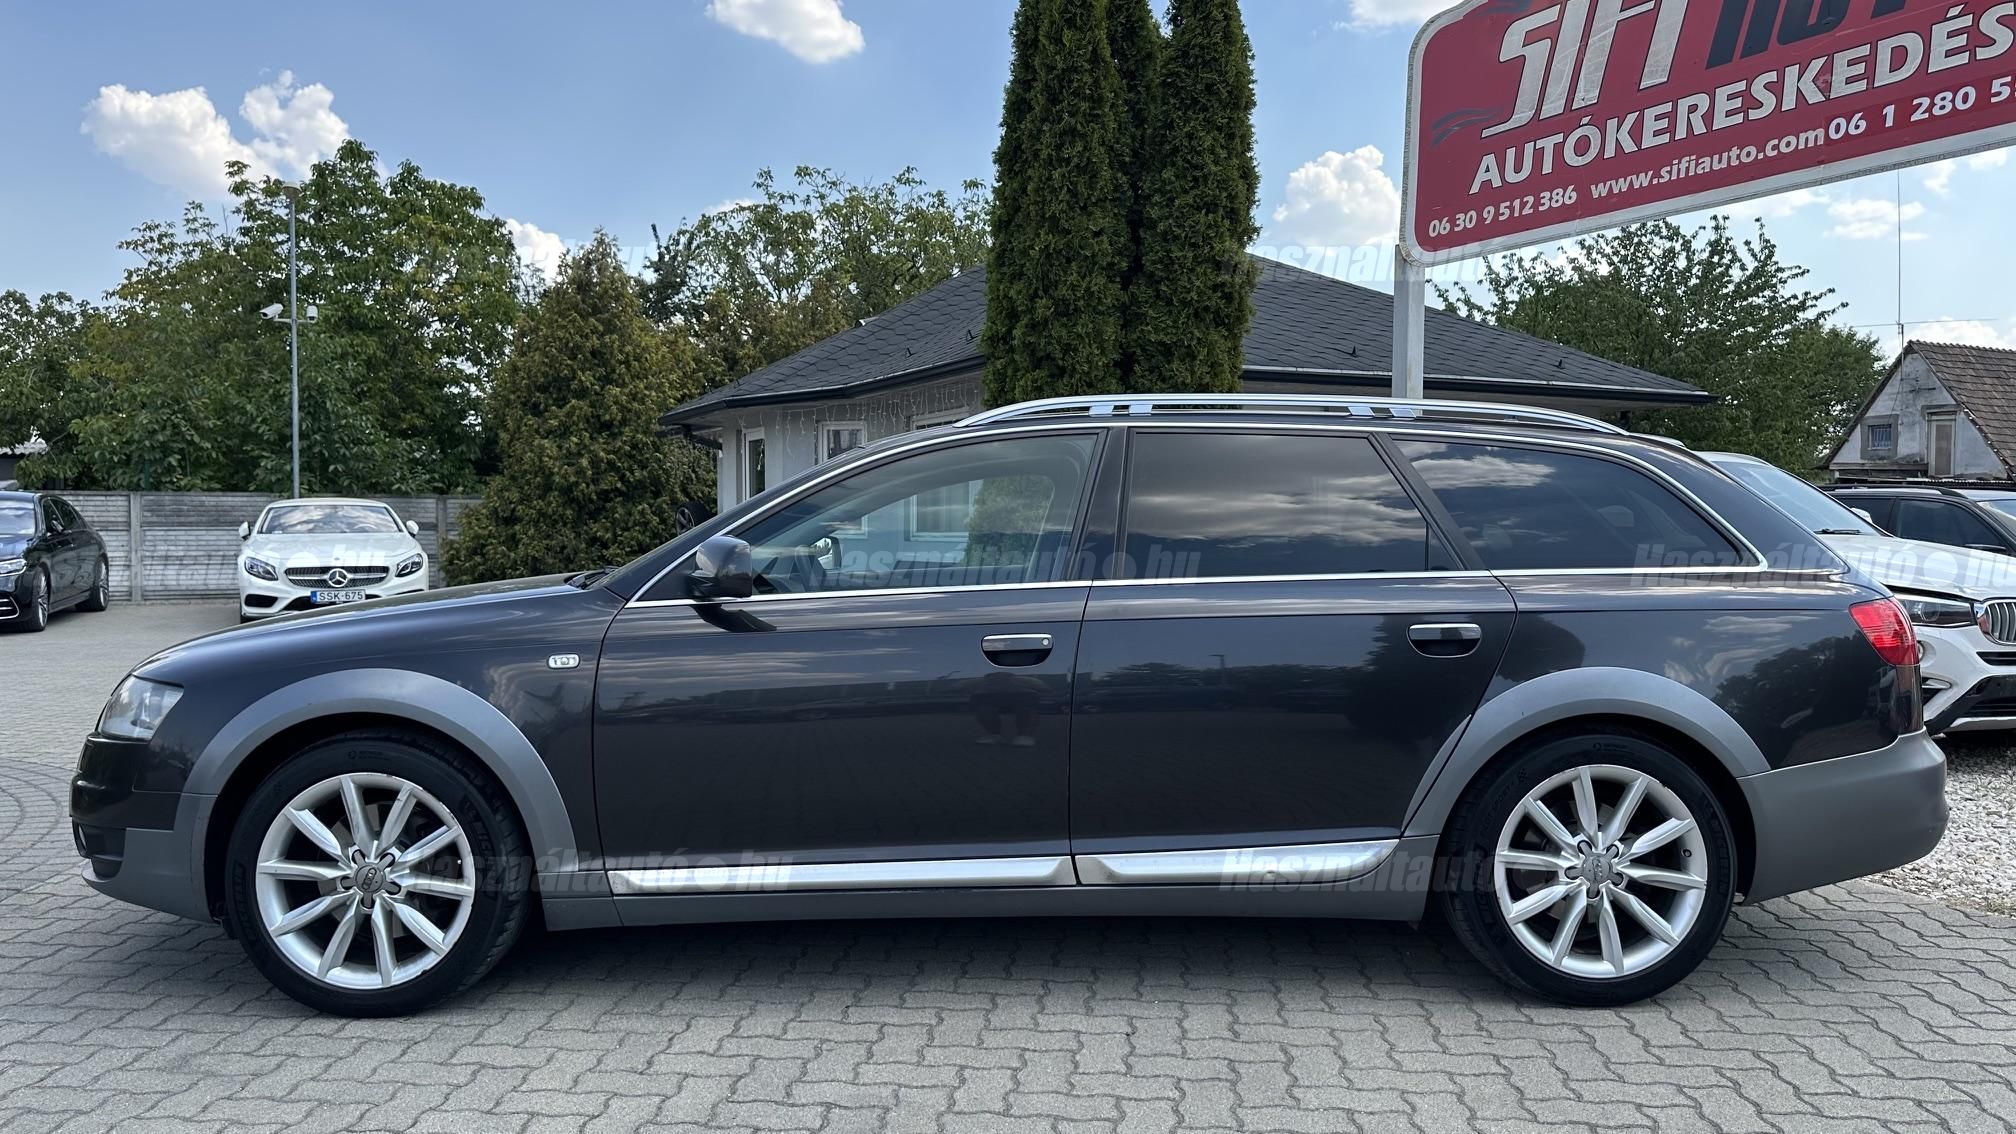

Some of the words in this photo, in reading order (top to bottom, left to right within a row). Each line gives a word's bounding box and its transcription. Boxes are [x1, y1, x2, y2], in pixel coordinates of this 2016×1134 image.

[1428, 217, 1450, 237] 06
[1454, 210, 1477, 231] 30
[1498, 195, 1534, 220] 512
[1538, 185, 1577, 211] 386
[1590, 128, 1824, 199] www.sifiauto.com
[1828, 112, 1867, 140] 06
[1882, 104, 1896, 128] 1
[1910, 85, 1976, 122] 280
[1469, 2, 2015, 194] AUTÓKERESKEDÉS
